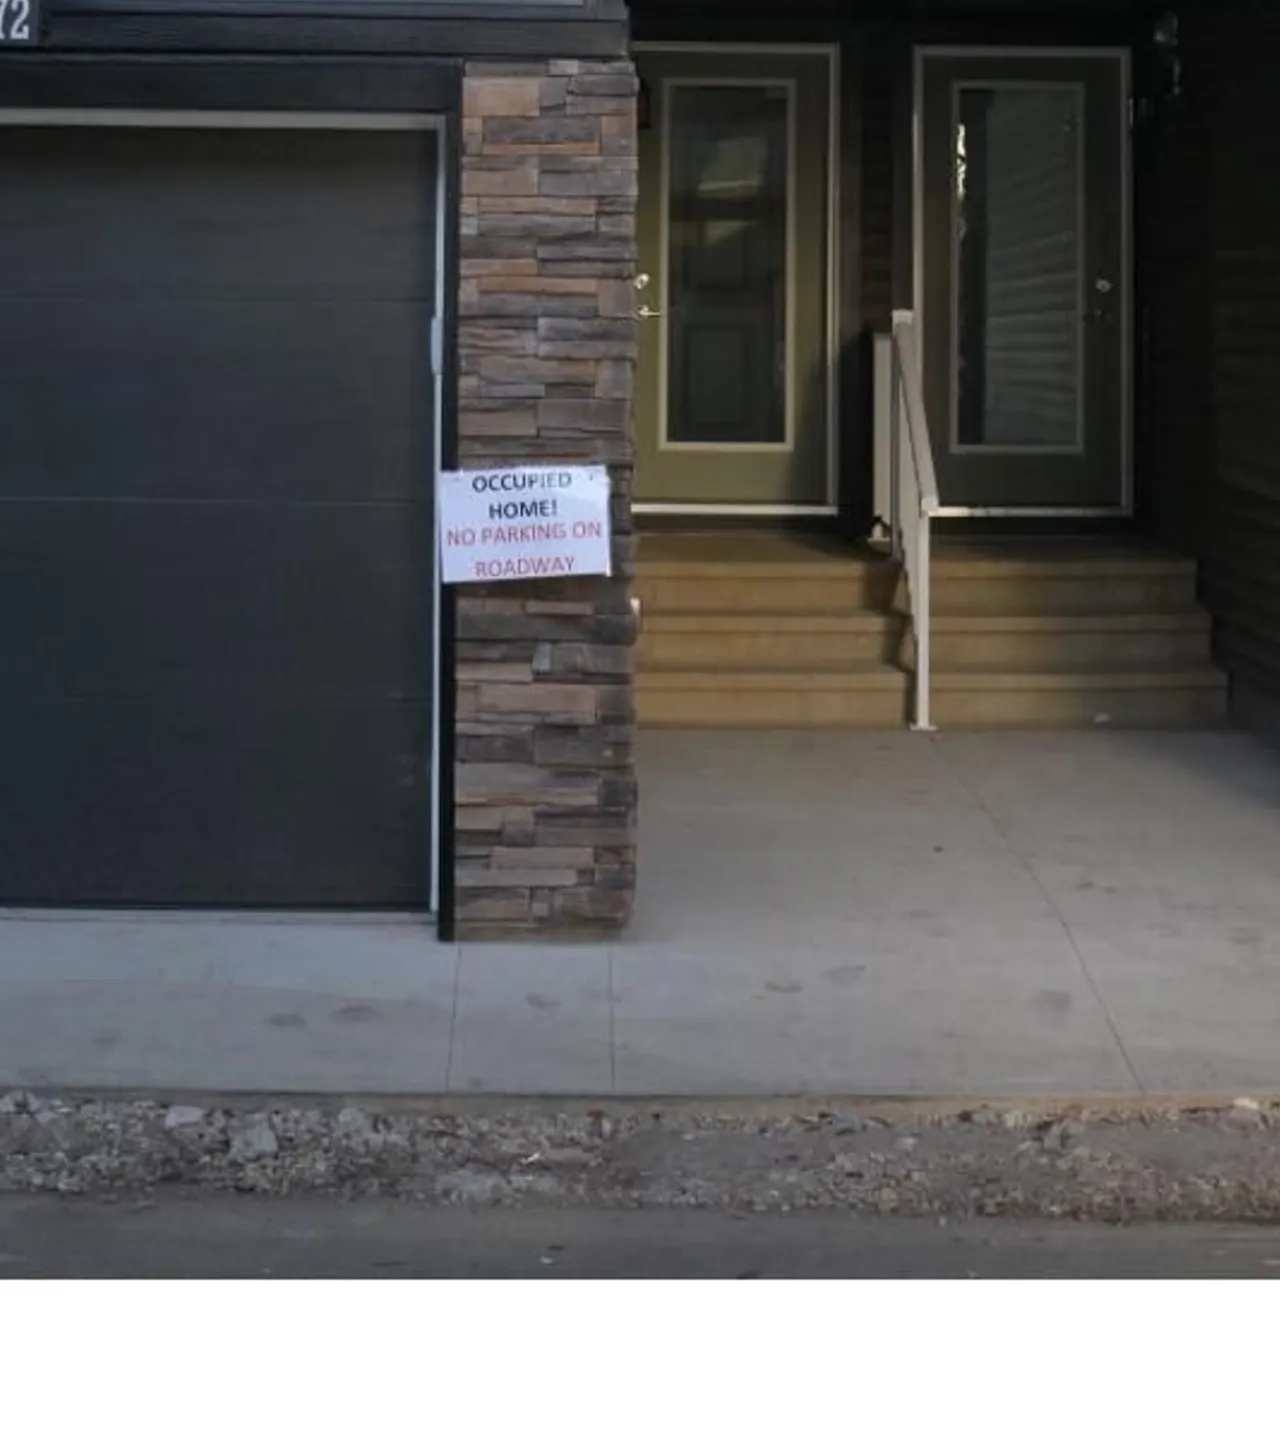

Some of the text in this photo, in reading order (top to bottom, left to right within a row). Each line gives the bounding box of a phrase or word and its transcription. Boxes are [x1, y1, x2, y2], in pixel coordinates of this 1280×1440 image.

[471, 472, 572, 493] OCCUPIED
[488, 500, 558, 520] HOME!
[447, 521, 602, 547] NO PARKING ON
[474, 556, 576, 578] ROADWAY
